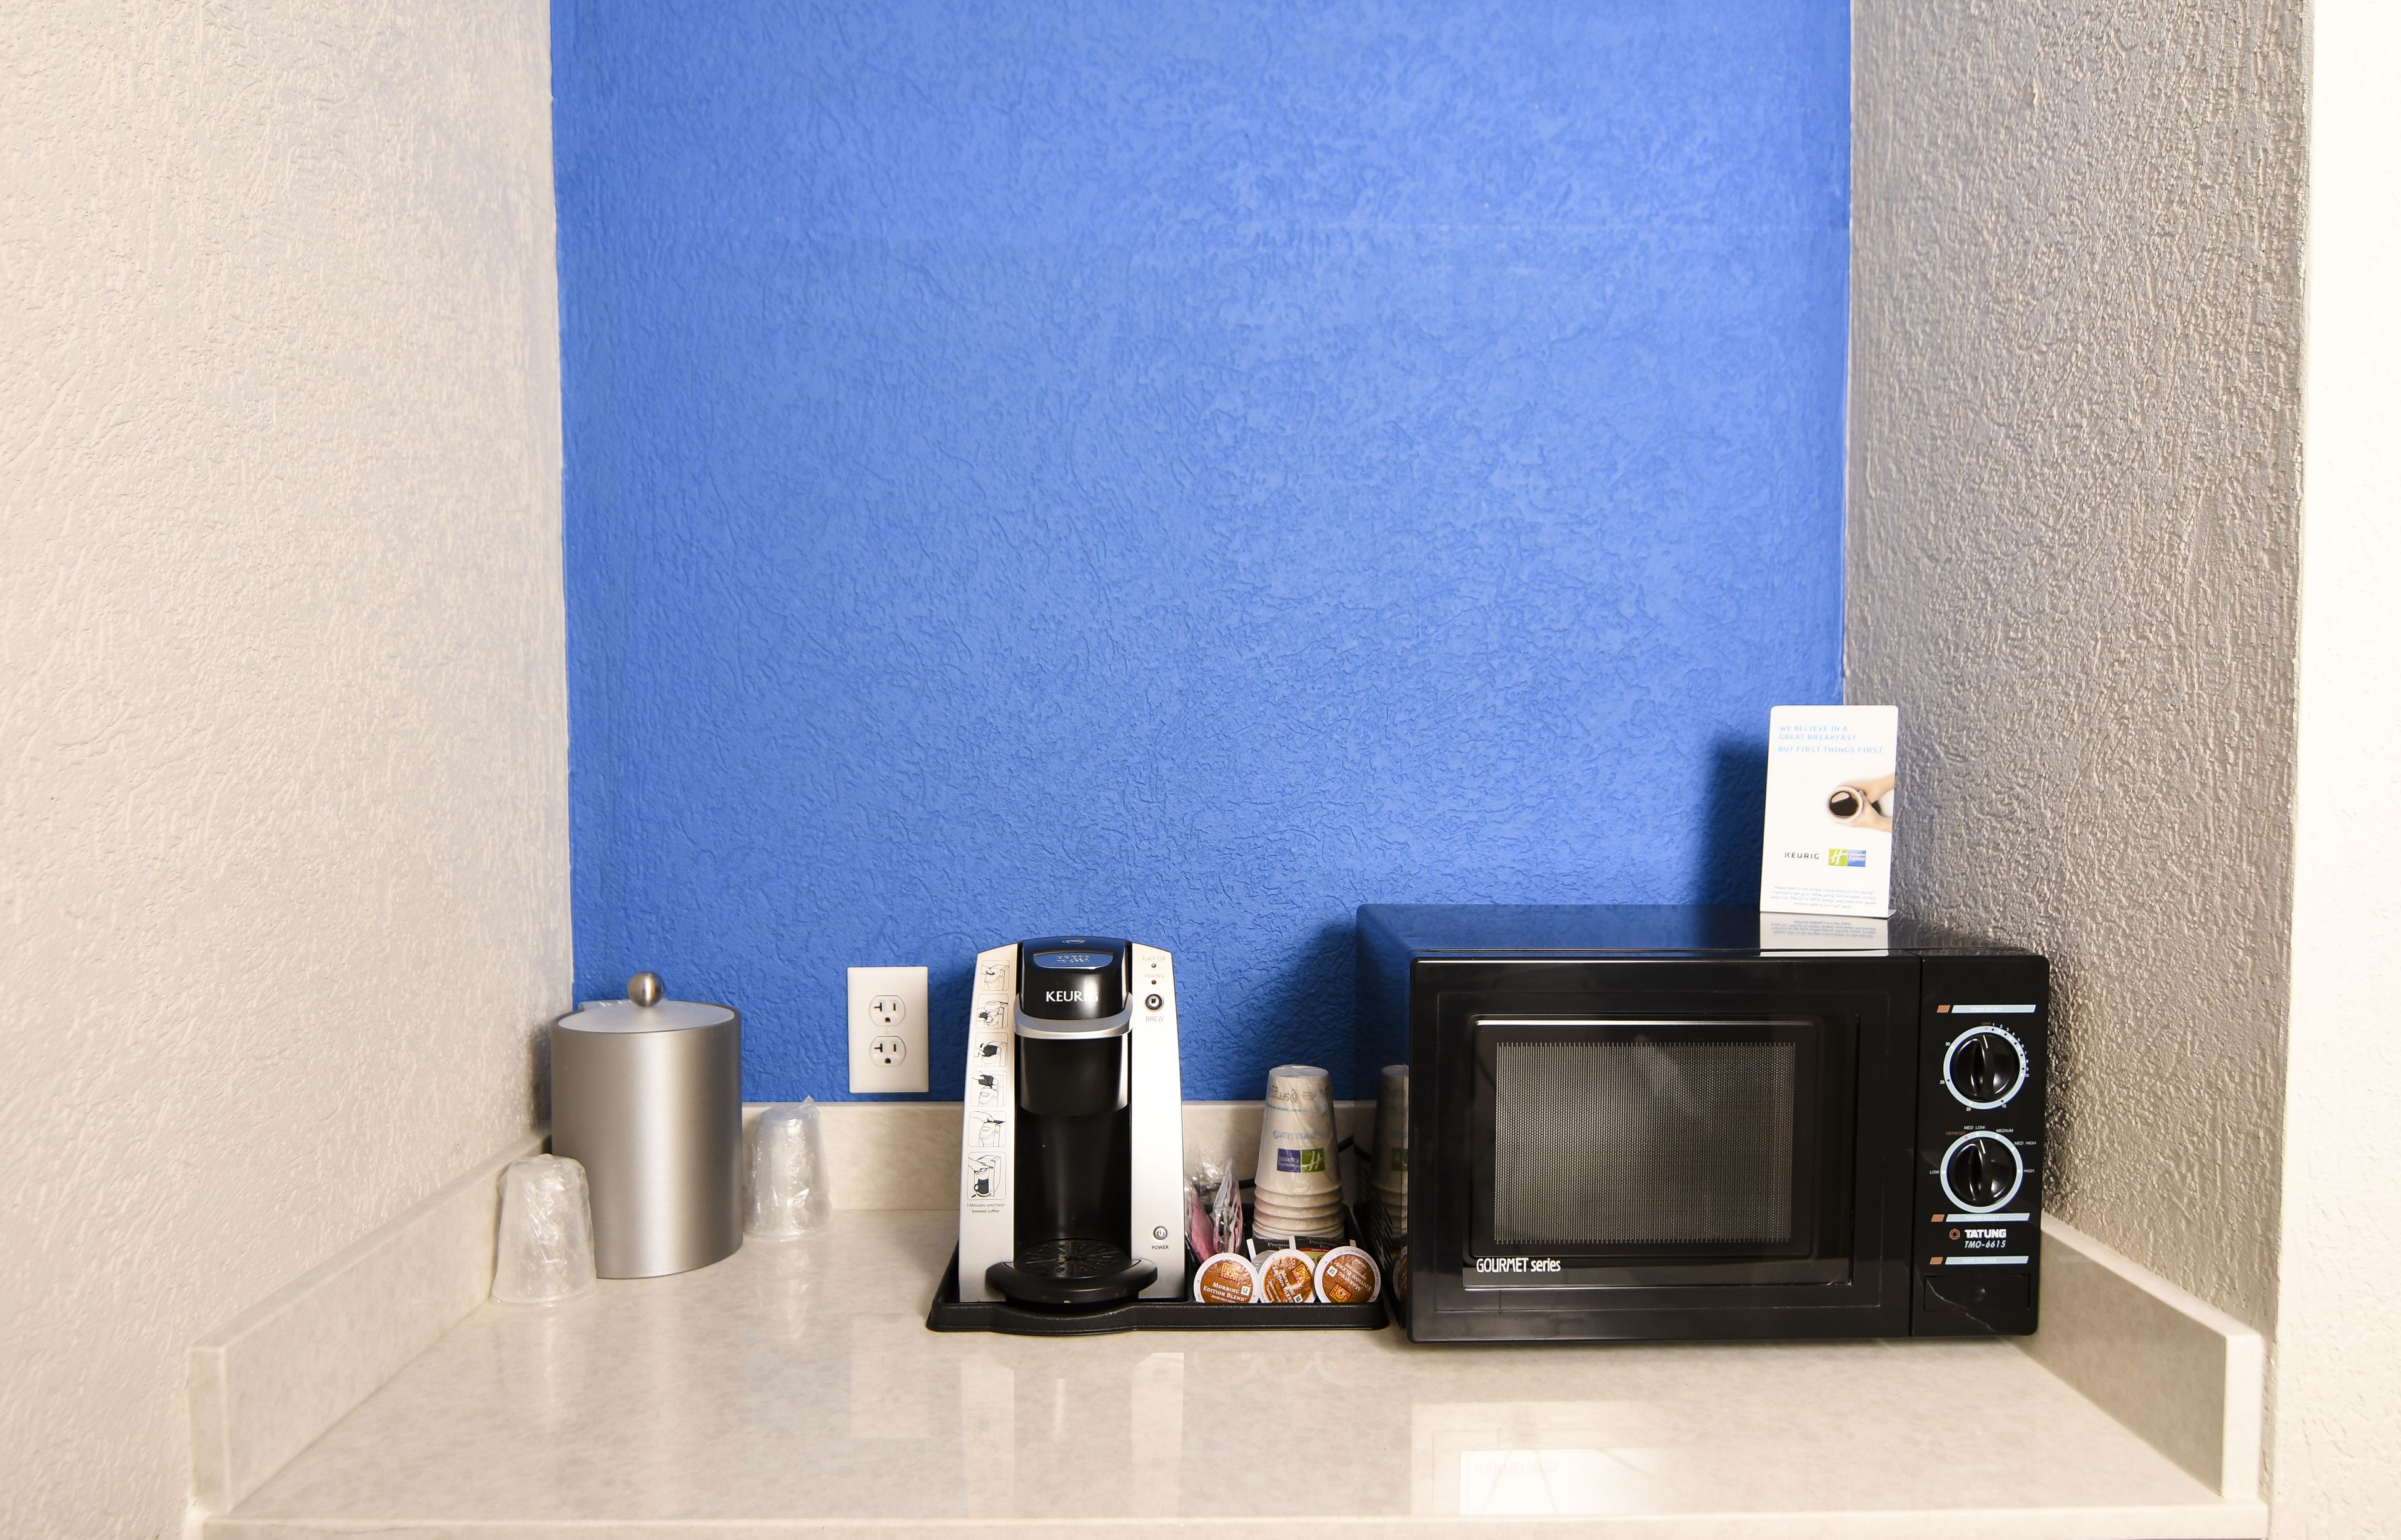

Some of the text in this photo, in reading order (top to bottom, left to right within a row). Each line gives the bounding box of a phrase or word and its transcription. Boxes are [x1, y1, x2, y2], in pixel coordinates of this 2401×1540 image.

[1784, 852, 1820, 860] KEURIG
[1965, 1229, 2006, 1238] TATUNG
[1965, 1240, 2006, 1248] TMO-6615
[1476, 1257, 1561, 1272] GOURMET series
[1212, 1282, 1240, 1294] MORNING
[1352, 1274, 1372, 1291] EDITION
[1203, 1285, 1226, 1297] EDITION
